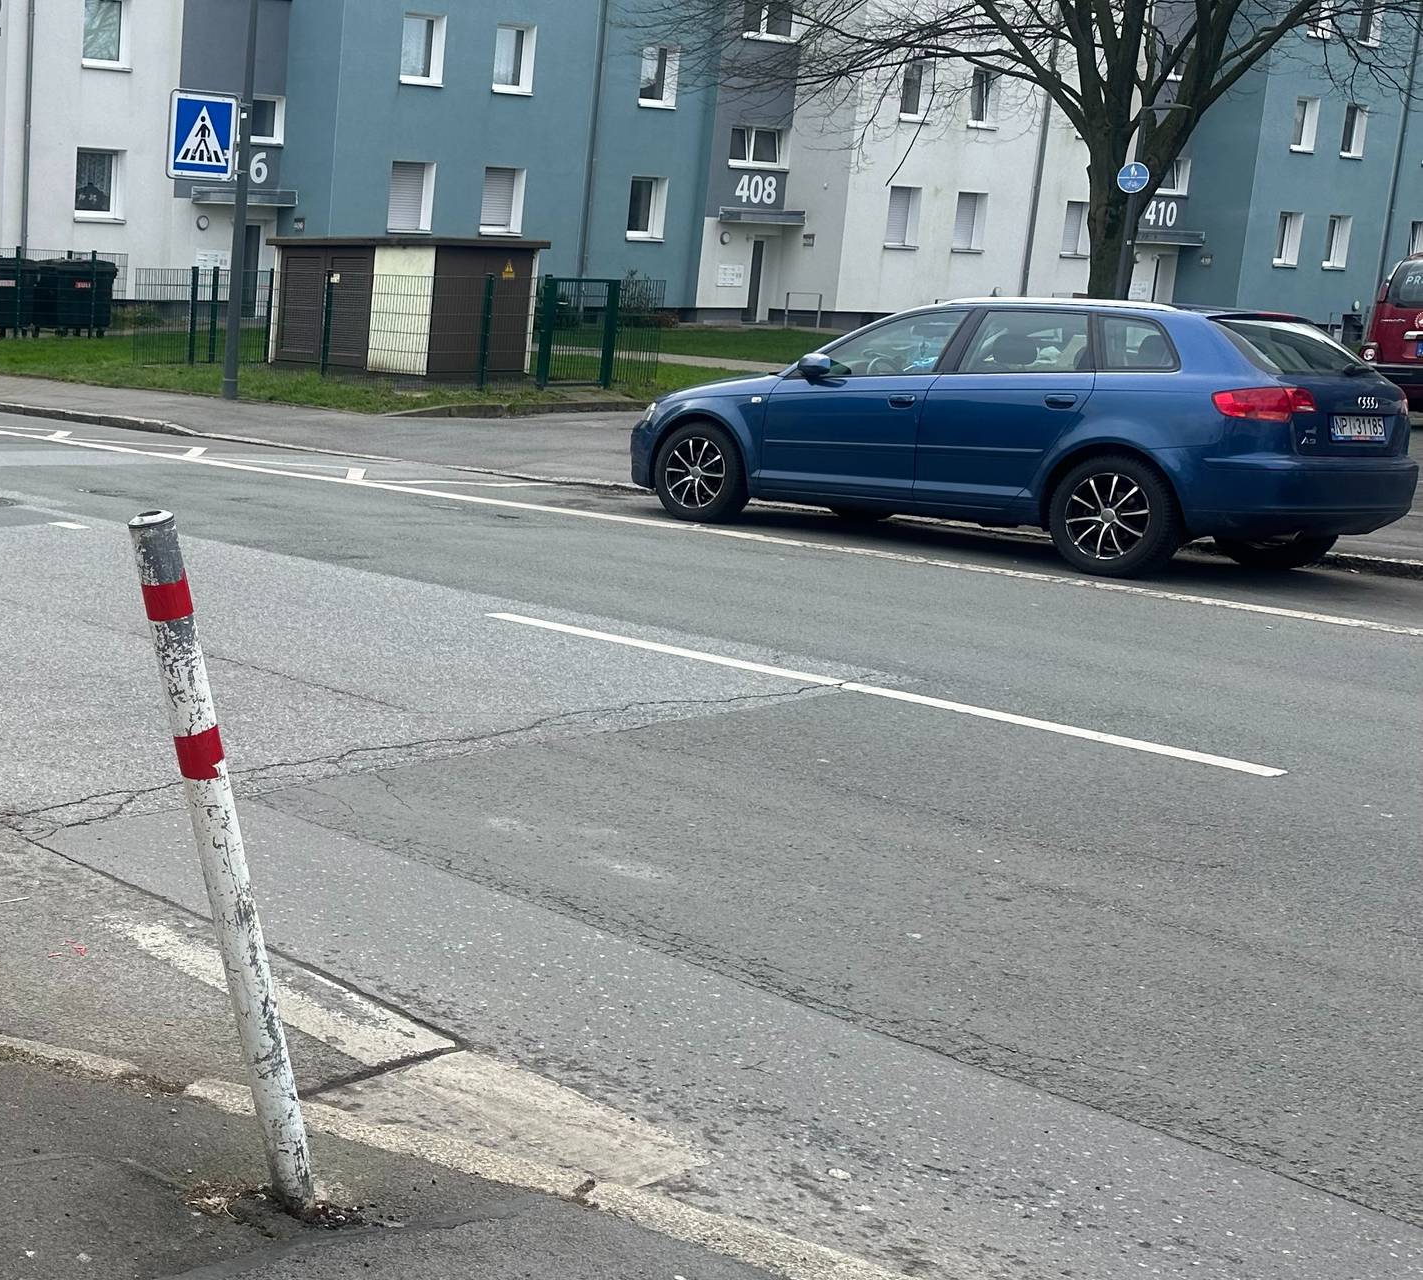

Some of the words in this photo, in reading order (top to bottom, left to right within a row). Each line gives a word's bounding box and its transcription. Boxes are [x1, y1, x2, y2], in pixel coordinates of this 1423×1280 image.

[735, 174, 777, 204] 408
[1145, 200, 1177, 227] 410
[1405, 275, 1423, 285] PR
[1356, 417, 1384, 435] 31185
